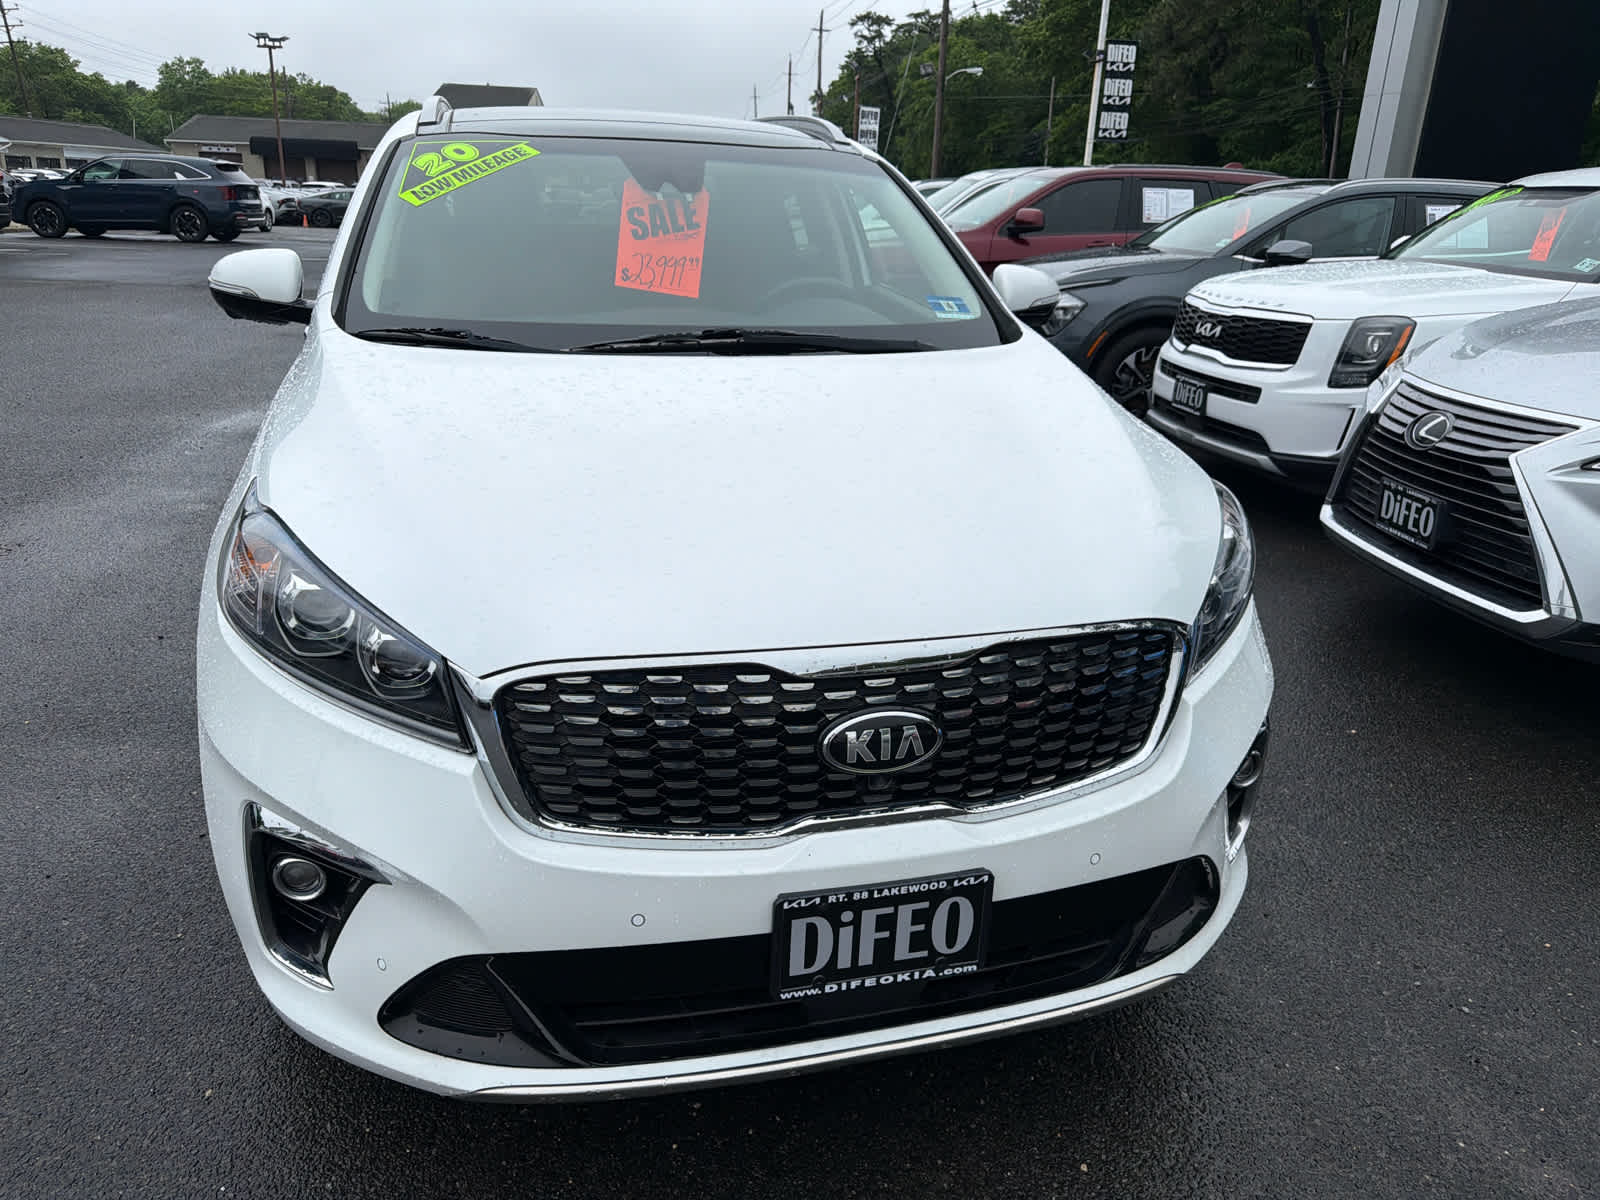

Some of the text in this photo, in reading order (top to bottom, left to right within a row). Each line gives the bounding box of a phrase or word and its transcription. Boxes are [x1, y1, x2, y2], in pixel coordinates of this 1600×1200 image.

[410, 146, 528, 201] LOW MILEAGE
[412, 143, 481, 177] 20
[626, 200, 702, 241] SALE
[1380, 489, 1434, 537] DiFEO
[845, 725, 925, 763] KIA
[827, 893, 848, 904] RT.
[853, 891, 869, 900] 88
[873, 880, 948, 899] LAKEWOOD
[789, 896, 974, 977] DiFEO
[779, 963, 978, 1000] www.DIFEOKIA.com
